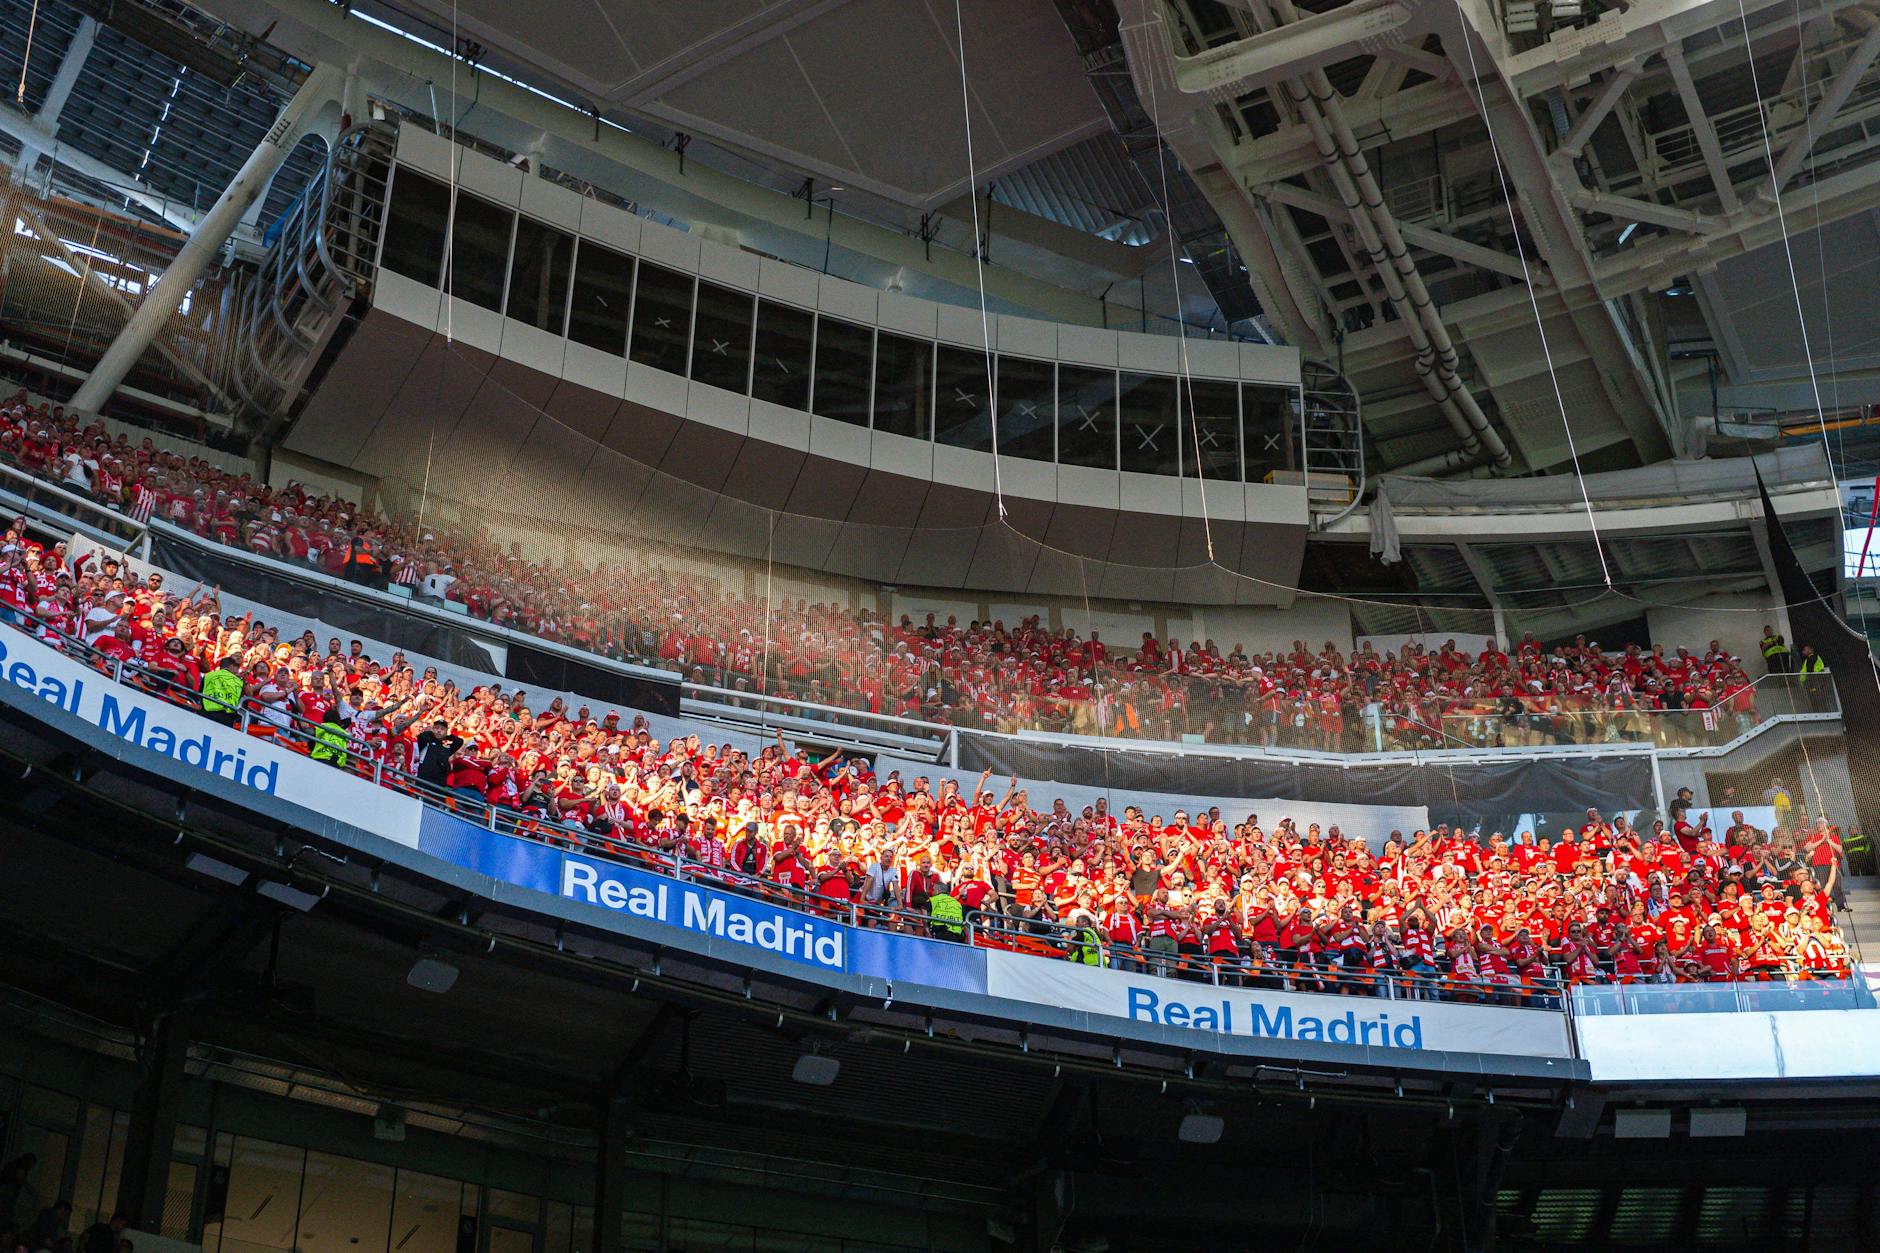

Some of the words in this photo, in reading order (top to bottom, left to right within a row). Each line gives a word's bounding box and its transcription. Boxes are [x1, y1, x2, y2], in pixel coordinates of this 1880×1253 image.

[0, 640, 83, 716] eal
[98, 693, 279, 797] Madrid
[563, 860, 668, 921] Real
[684, 891, 843, 968] Madrid
[1128, 986, 1232, 1036] Real
[1250, 1003, 1423, 1050] Madrid
